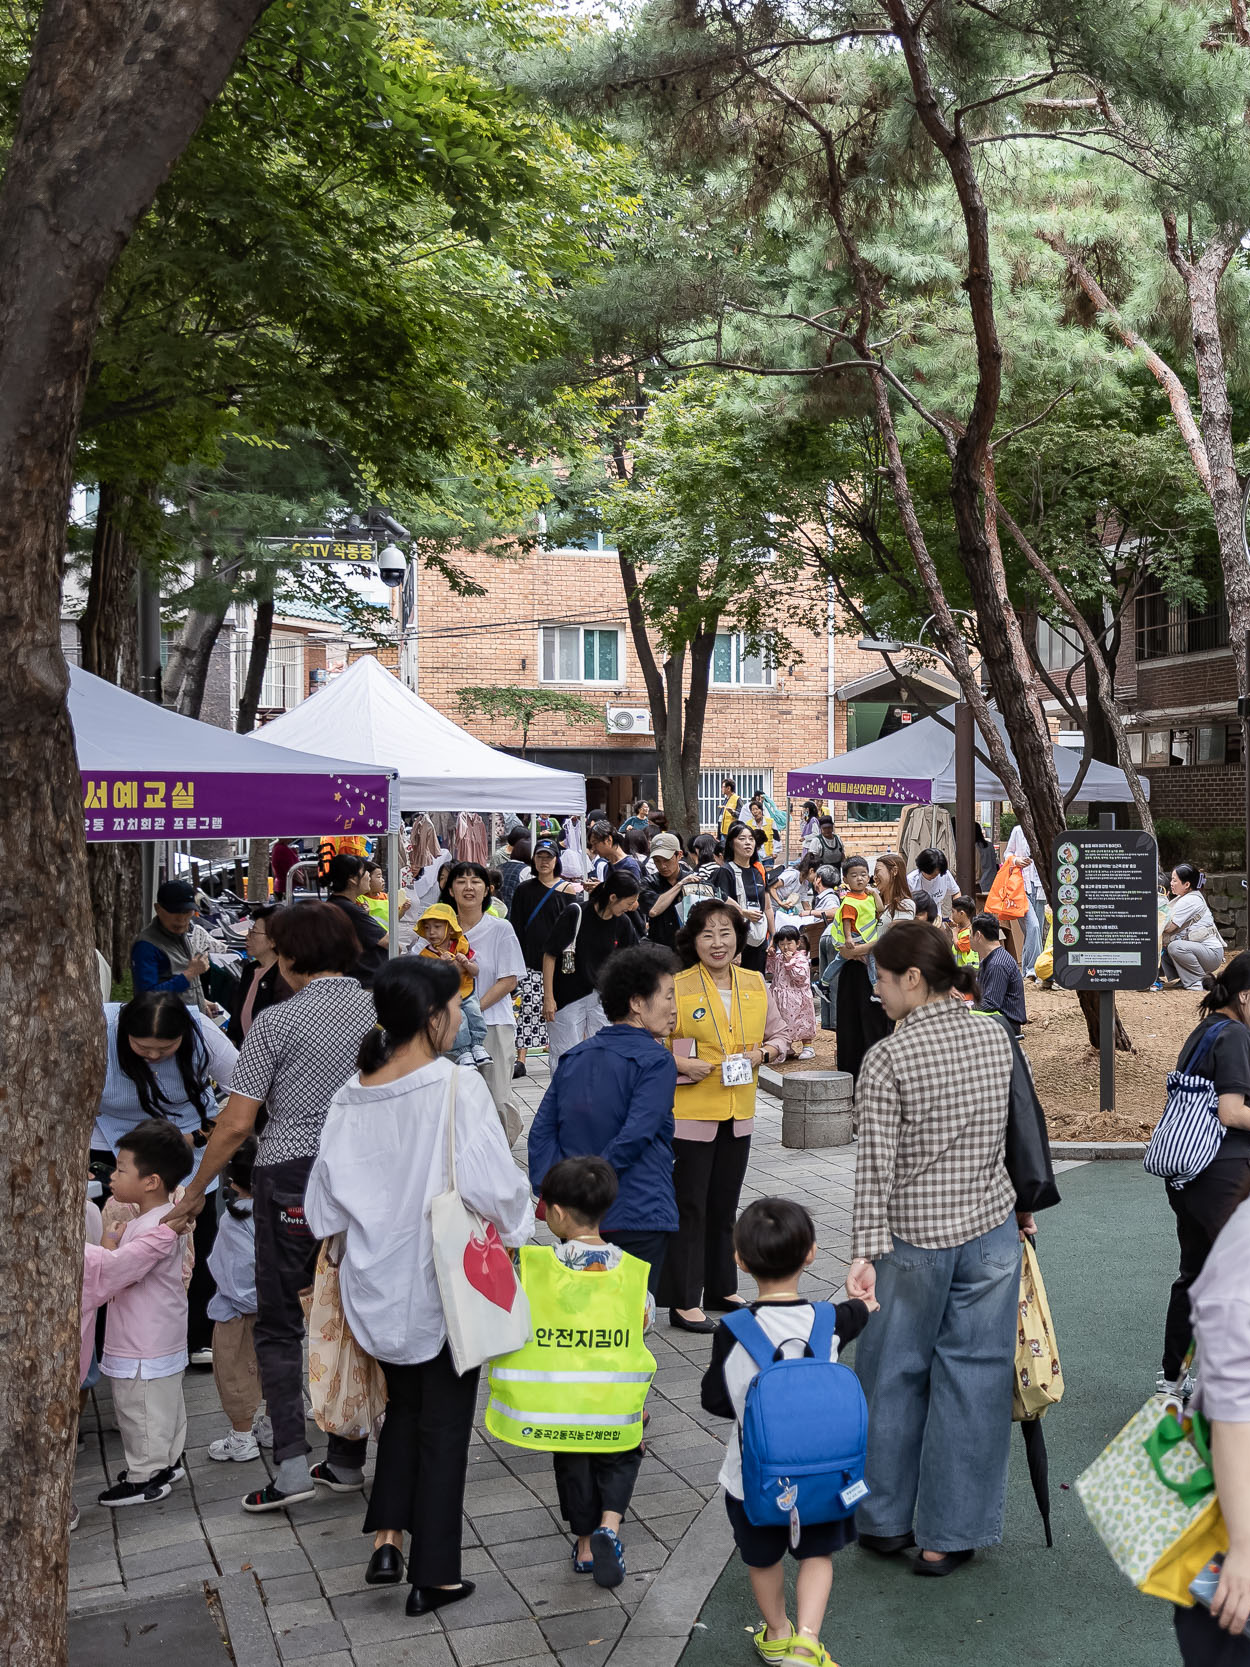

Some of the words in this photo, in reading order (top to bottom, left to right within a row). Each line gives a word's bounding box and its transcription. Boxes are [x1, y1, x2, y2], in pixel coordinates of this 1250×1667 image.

[291, 543, 330, 557] CCTV
[333, 543, 373, 560] 작동중
[84, 781, 194, 809] 서예교실
[113, 818, 166, 830] 자치회관
[174, 817, 223, 830] 프로그램
[536, 1328, 629, 1348] 안전지킴이
